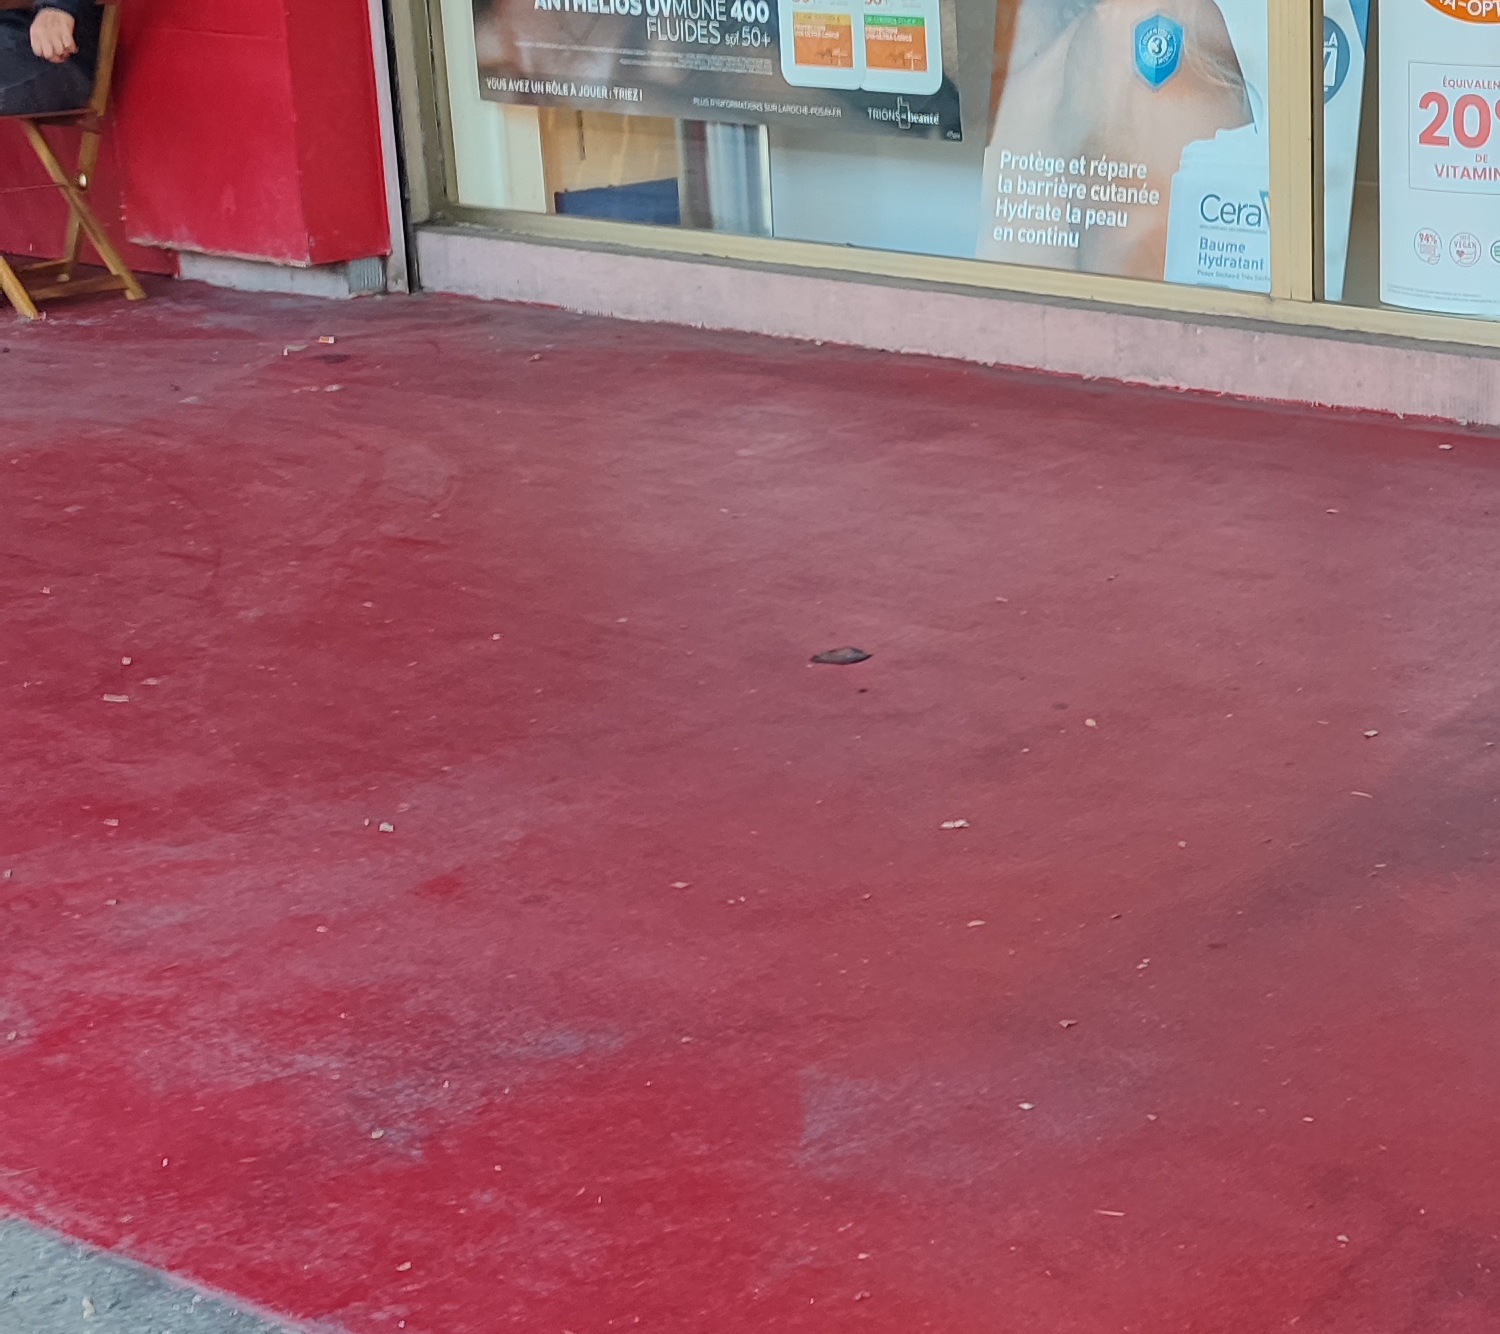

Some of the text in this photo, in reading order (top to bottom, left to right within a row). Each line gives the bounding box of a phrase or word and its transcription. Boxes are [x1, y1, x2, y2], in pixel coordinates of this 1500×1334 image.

[730, 0, 770, 24] 400
[646, 20, 721, 46] FLUIDES
[1151, 36, 1163, 55] 3
[486, 77, 508, 91] VOUS
[508, 78, 530, 93] AVEZ
[531, 81, 544, 95] UN
[1000, 149, 1148, 182] Protège et répare
[1475, 153, 1488, 164] DE
[997, 174, 1160, 206] la barrière cutanée
[995, 197, 1128, 231] Hydrate la peau
[993, 225, 1080, 249] en continu
[1200, 235, 1246, 254] Baume
[1198, 252, 1264, 271] Hydratant
